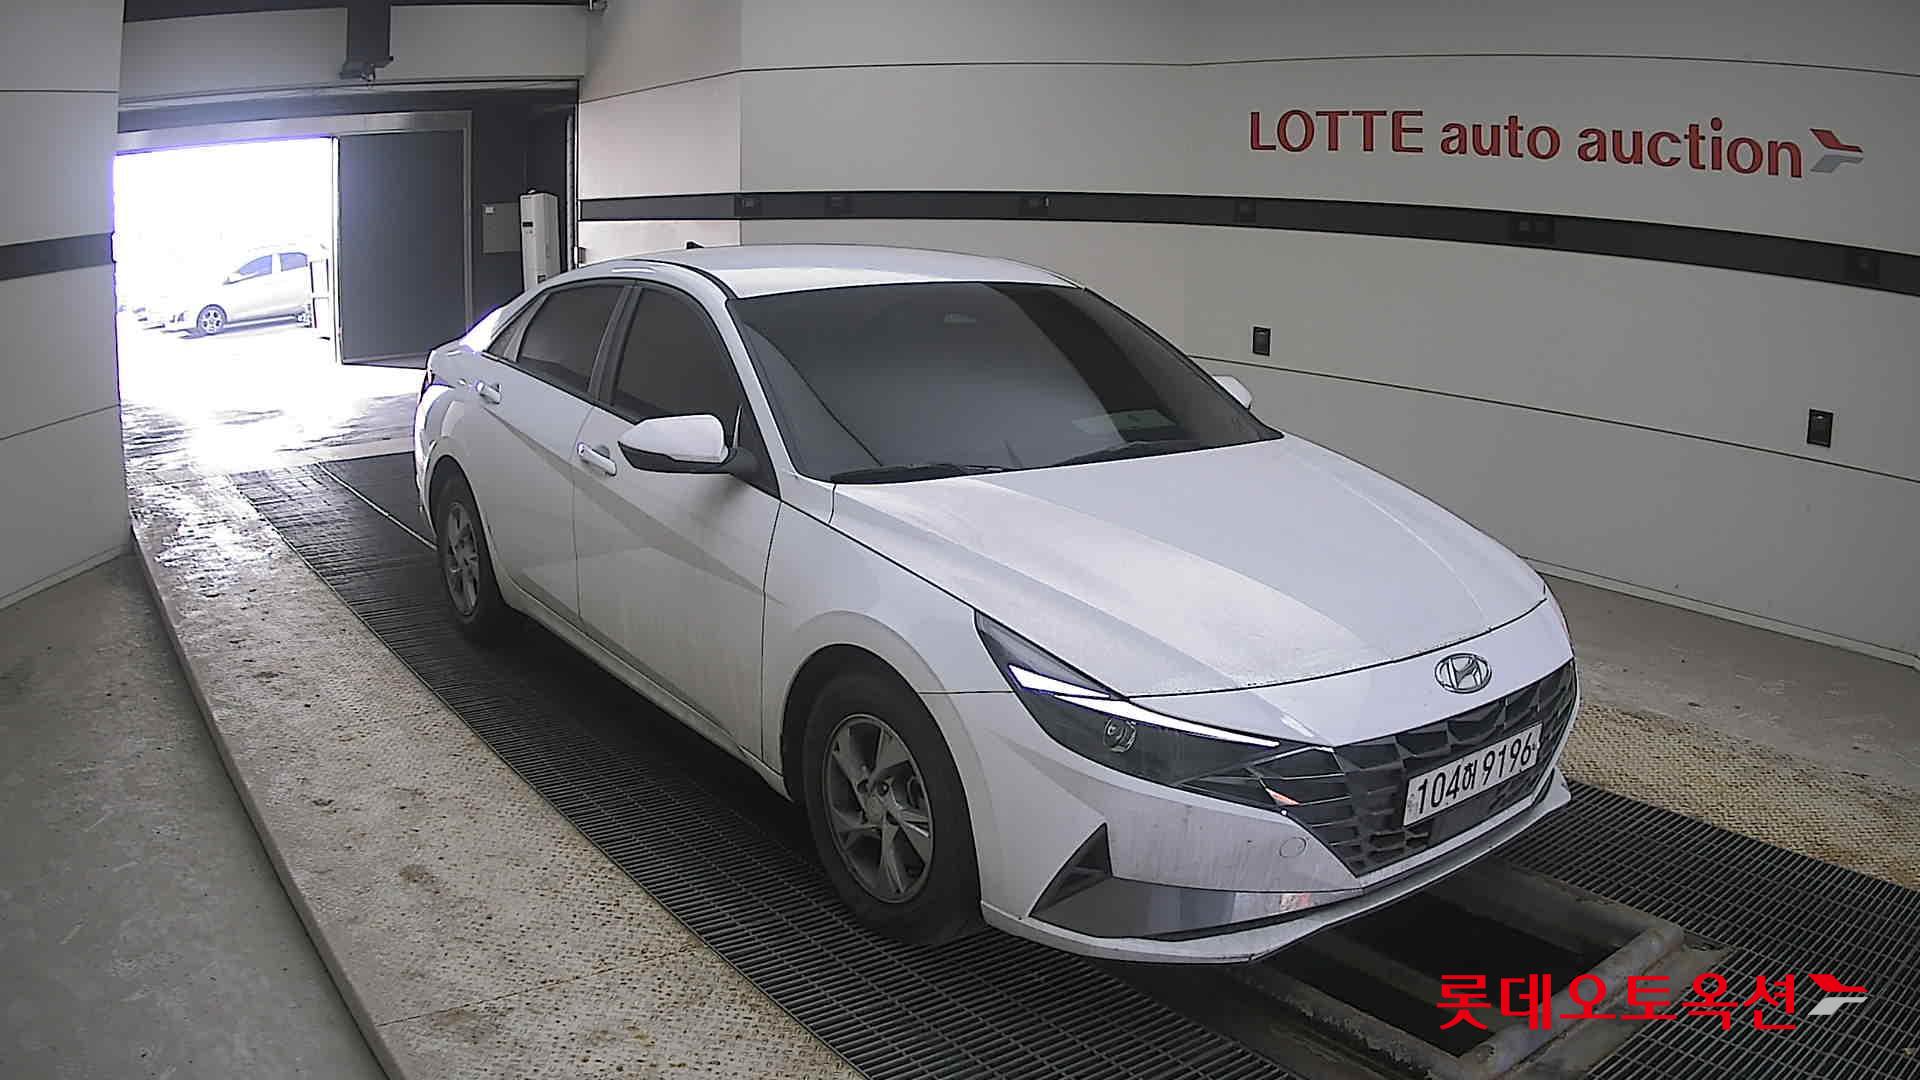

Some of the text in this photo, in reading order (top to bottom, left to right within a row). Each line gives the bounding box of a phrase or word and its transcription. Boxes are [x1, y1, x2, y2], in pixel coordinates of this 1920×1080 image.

[1250, 110, 1803, 178] LOTTE auto auction
